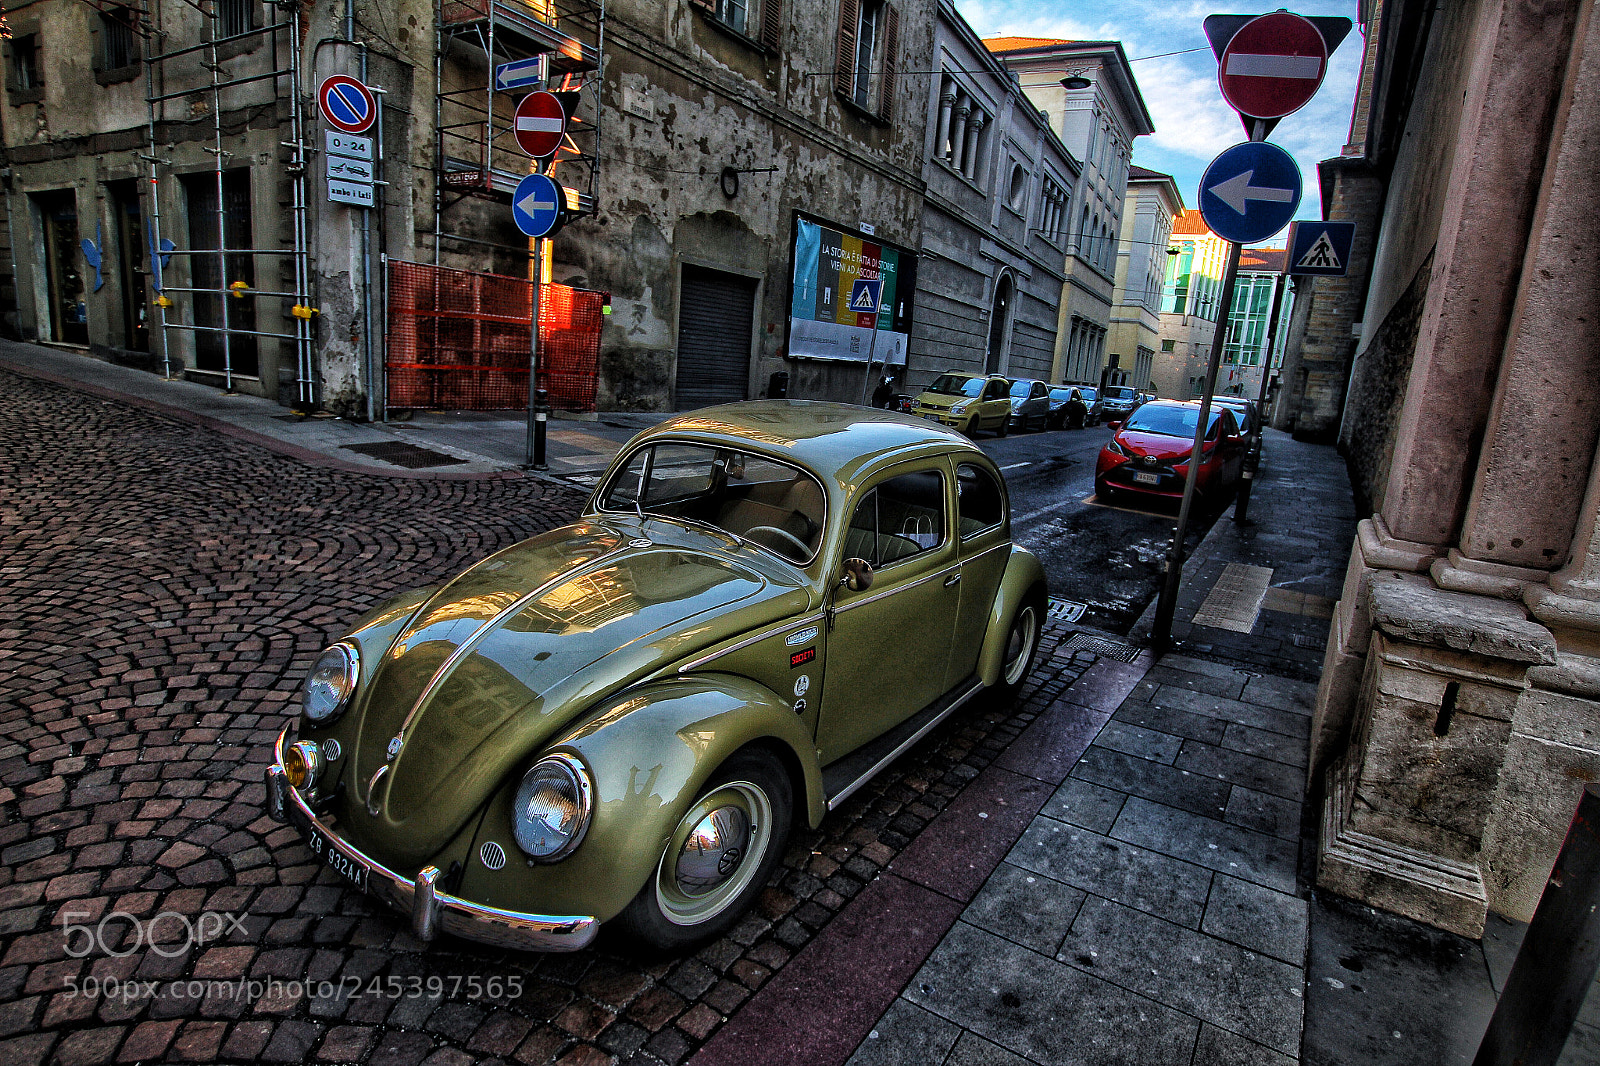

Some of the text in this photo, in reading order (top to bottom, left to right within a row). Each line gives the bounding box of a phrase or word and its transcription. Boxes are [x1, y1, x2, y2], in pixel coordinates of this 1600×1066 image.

[333, 138, 341, 147] 0
[351, 141, 366, 152] 24
[331, 188, 350, 198] ambo
[358, 190, 372, 200] lati
[822, 243, 830, 255] LA
[830, 246, 851, 261] STORIA
[856, 254, 871, 267] FATTA
[871, 258, 878, 268] DI
[831, 259, 846, 272] VIENI
[846, 265, 856, 275] AD
[309, 831, 322, 853] ZB
